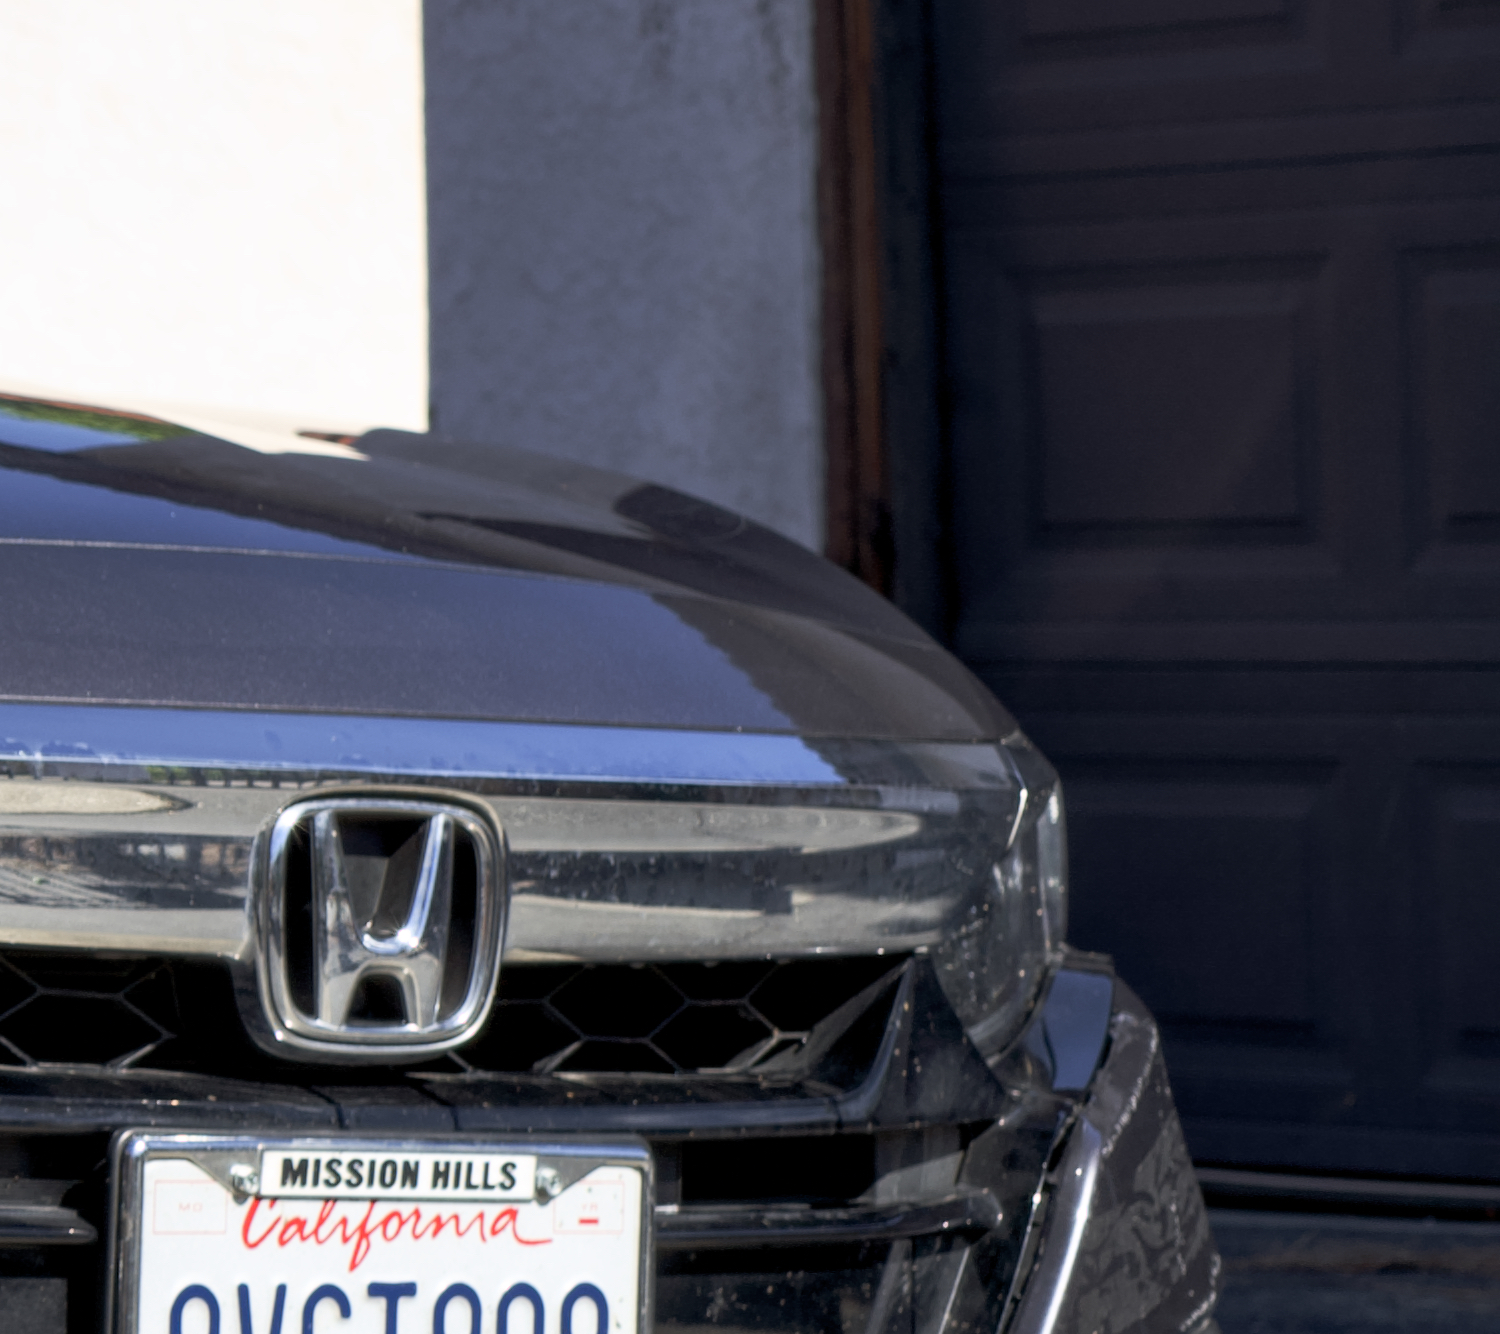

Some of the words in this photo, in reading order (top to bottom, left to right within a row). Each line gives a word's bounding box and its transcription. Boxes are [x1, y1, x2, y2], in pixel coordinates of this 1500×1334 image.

[280, 1157, 419, 1189] MISSION
[431, 1160, 517, 1191] HILLS
[240, 1197, 553, 1273] California
